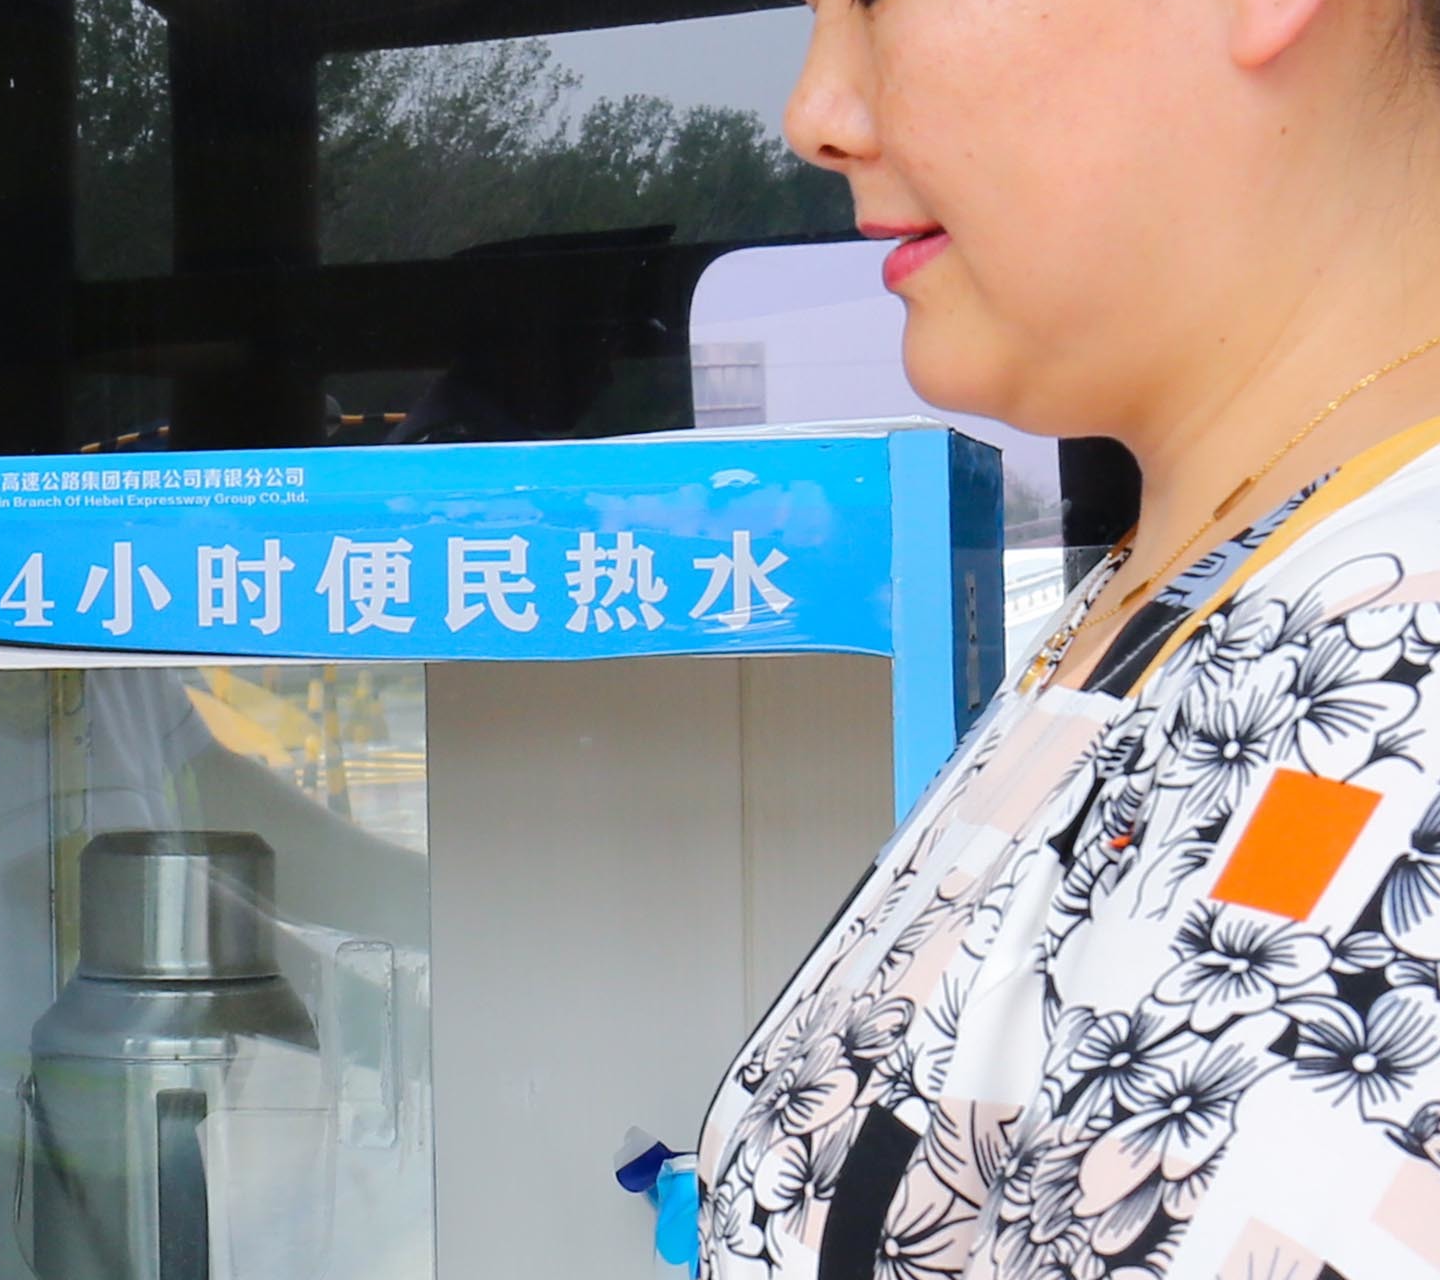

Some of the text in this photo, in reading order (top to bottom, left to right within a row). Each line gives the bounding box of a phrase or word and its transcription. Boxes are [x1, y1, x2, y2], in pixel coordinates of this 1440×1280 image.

[13, 496, 62, 509] Branch
[65, 495, 82, 507] Of
[84, 494, 124, 507] Hebei
[128, 493, 211, 507] Expressway
[214, 492, 257, 506] Group
